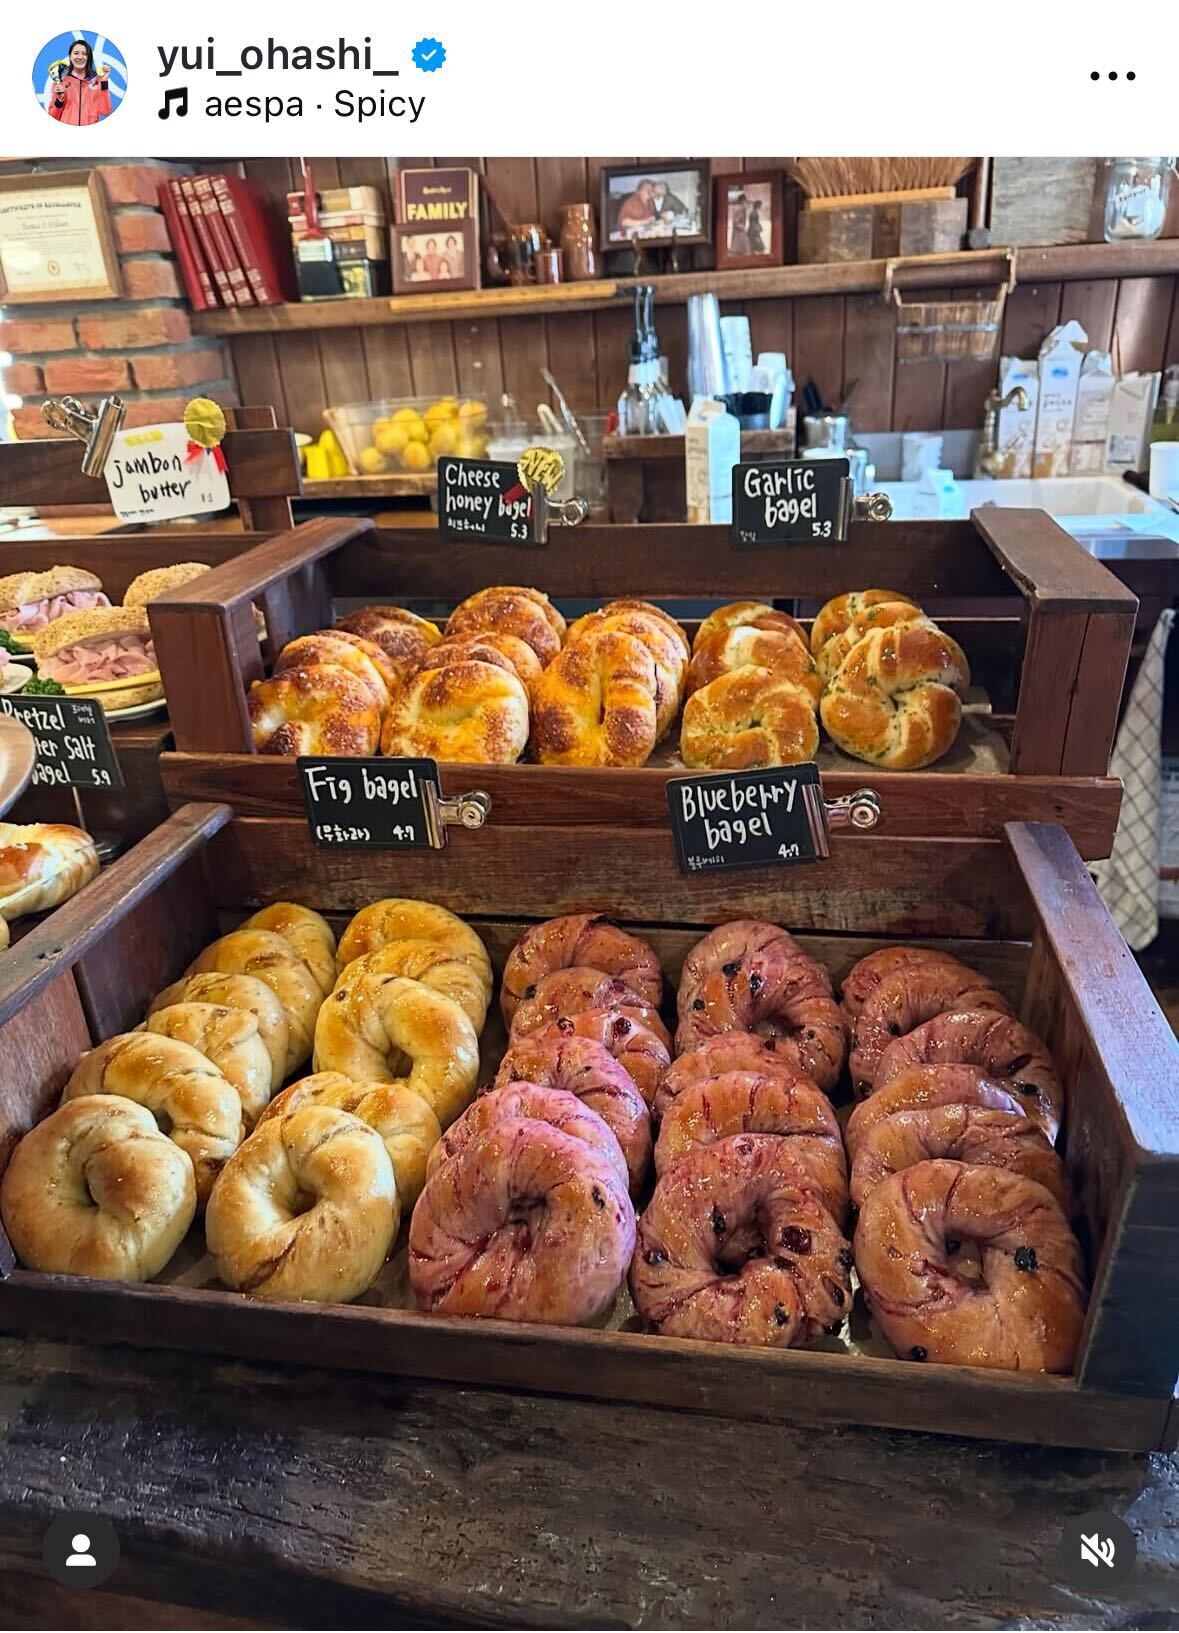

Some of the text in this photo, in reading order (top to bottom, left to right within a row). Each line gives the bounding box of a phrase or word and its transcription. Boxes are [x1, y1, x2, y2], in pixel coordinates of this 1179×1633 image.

[407, 201, 468, 221] FAMILY
[112, 451, 183, 489] jambon
[445, 463, 500, 489] Cheese
[139, 480, 192, 504] butter
[744, 468, 815, 499] Garlic
[445, 486, 532, 521] honey bagel
[764, 492, 817, 528] bagel
[510, 522, 528, 540] 5.3
[811, 520, 832, 538] 5.3
[34, 735, 96, 761] ter Salt
[91, 767, 112, 786] 5.9
[304, 766, 418, 805] Fig bagel
[681, 778, 797, 822] Blueberry
[704, 811, 772, 850] bagel
[778, 843, 800, 859] 4.7
